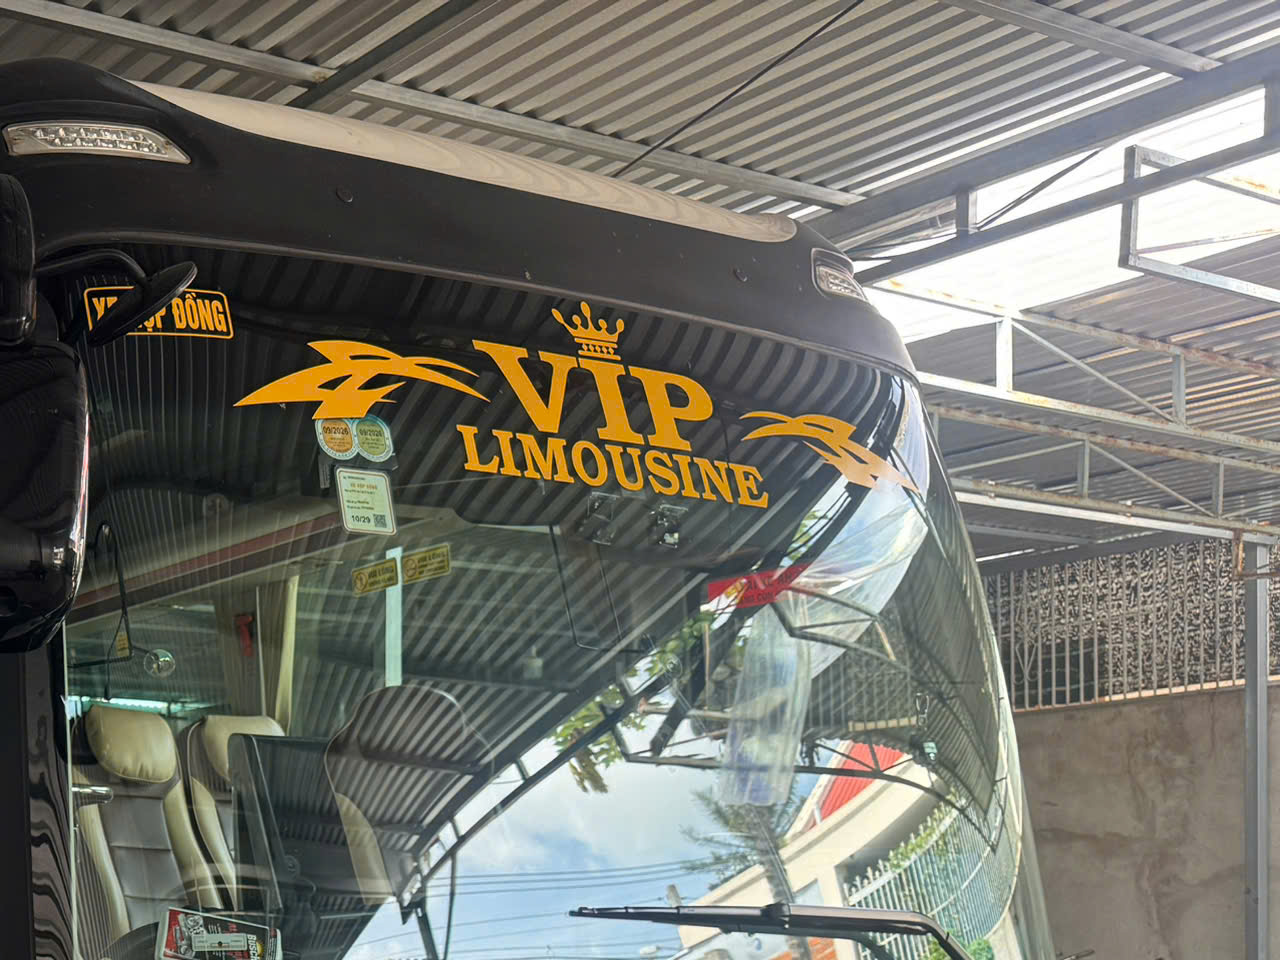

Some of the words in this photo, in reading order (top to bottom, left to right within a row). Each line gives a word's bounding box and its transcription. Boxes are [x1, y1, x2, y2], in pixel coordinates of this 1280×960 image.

[172, 293, 227, 333] ĐỒNG
[472, 339, 714, 452] VIP
[456, 424, 769, 508] LIMOUSINE
